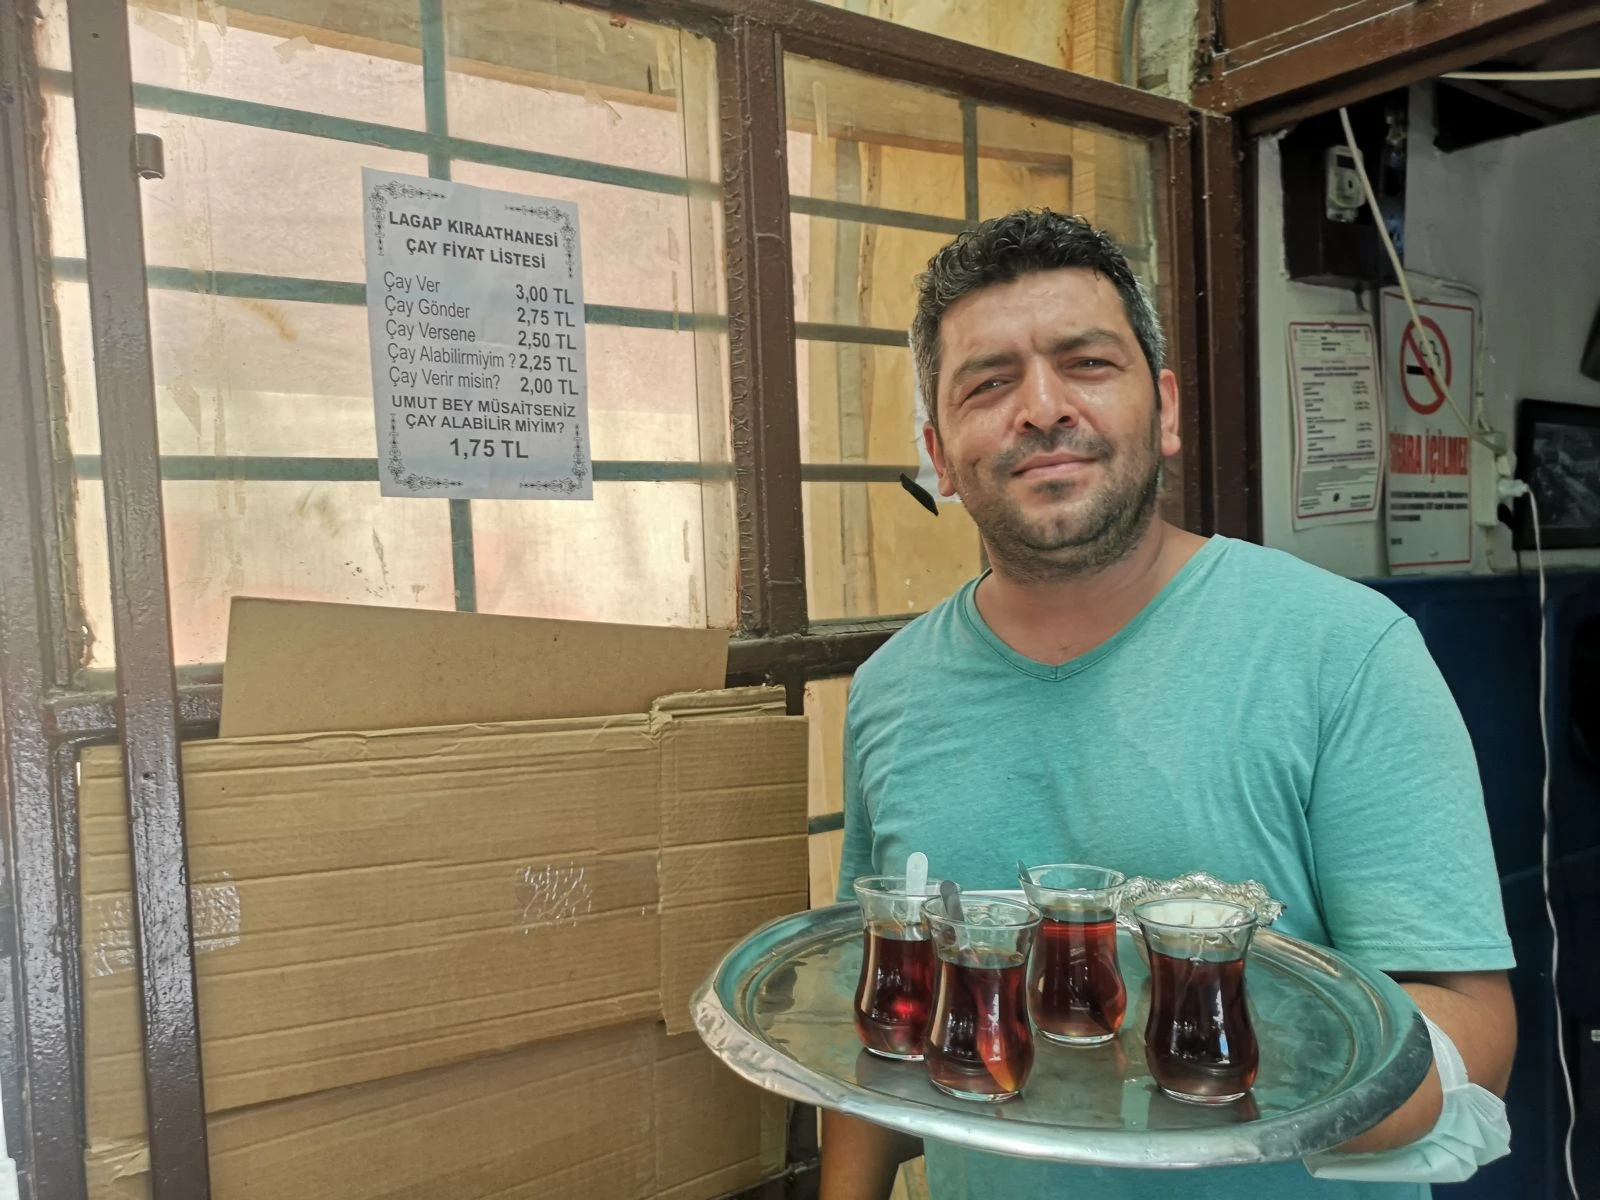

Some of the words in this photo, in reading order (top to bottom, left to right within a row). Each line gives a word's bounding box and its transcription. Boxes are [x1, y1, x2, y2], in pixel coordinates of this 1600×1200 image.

[389, 211, 442, 231] LAGAP
[448, 220, 558, 247] KIRAATHANESİ
[406, 239, 437, 257] ÇAY
[443, 243, 484, 261] FİYAT
[491, 249, 546, 269] LİSTESİ
[384, 272, 412, 291] Çay
[417, 276, 440, 293] Ver
[516, 284, 547, 303] 3,00
[553, 289, 574, 305] TL
[385, 295, 413, 315] Çay
[419, 299, 470, 319] Gönder
[517, 307, 549, 326] 2,75
[554, 311, 575, 328] TL
[386, 320, 414, 340] Çay
[419, 323, 476, 342] Versene
[518, 331, 551, 349] 2,50
[556, 334, 576, 350] TL
[387, 343, 416, 364] Çay
[420, 347, 505, 371] Alabilirmiyim
[509, 353, 516, 368] ?
[519, 354, 552, 372] 2,25
[556, 357, 578, 372] TL
[389, 367, 417, 388] Çay
[421, 371, 453, 387] Verir
[458, 375, 501, 389] misin?
[520, 377, 553, 395] 2,00
[557, 380, 579, 395] TL
[392, 396, 439, 409] UMUT
[443, 399, 473, 412] BEY
[478, 399, 576, 418] MÜSAİTSENİZ
[406, 414, 435, 429] ÇAY
[441, 415, 511, 431] ALABİLİR
[516, 420, 564, 433] MİYİM?
[450, 439, 495, 459] 1,75
[501, 441, 529, 458] TL
